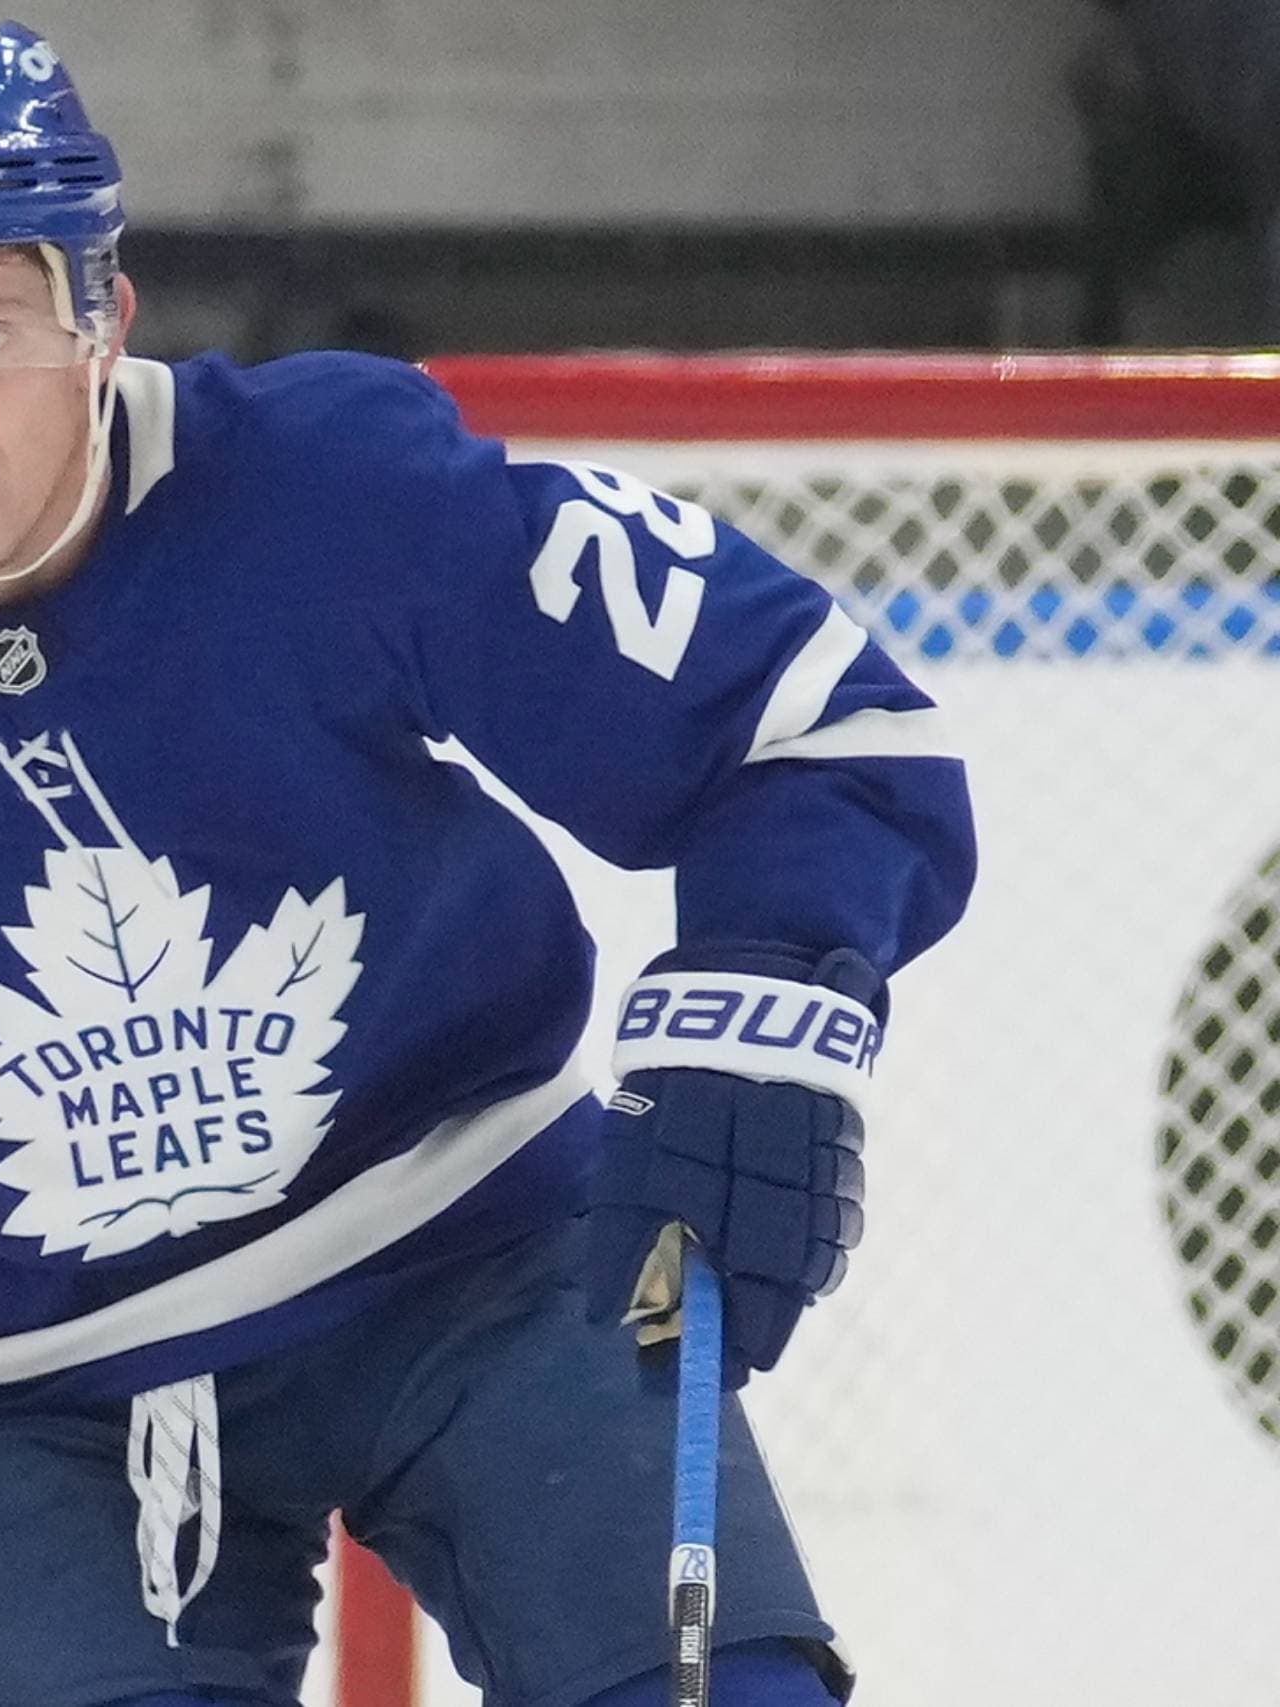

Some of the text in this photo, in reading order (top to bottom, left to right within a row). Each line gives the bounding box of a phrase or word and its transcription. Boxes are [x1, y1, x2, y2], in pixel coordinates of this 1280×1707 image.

[529, 459, 716, 682] 28
[59, 1058, 261, 1130] MAPLE
[71, 1110, 272, 1188] LEAFS
[677, 1547, 709, 1581] 28
